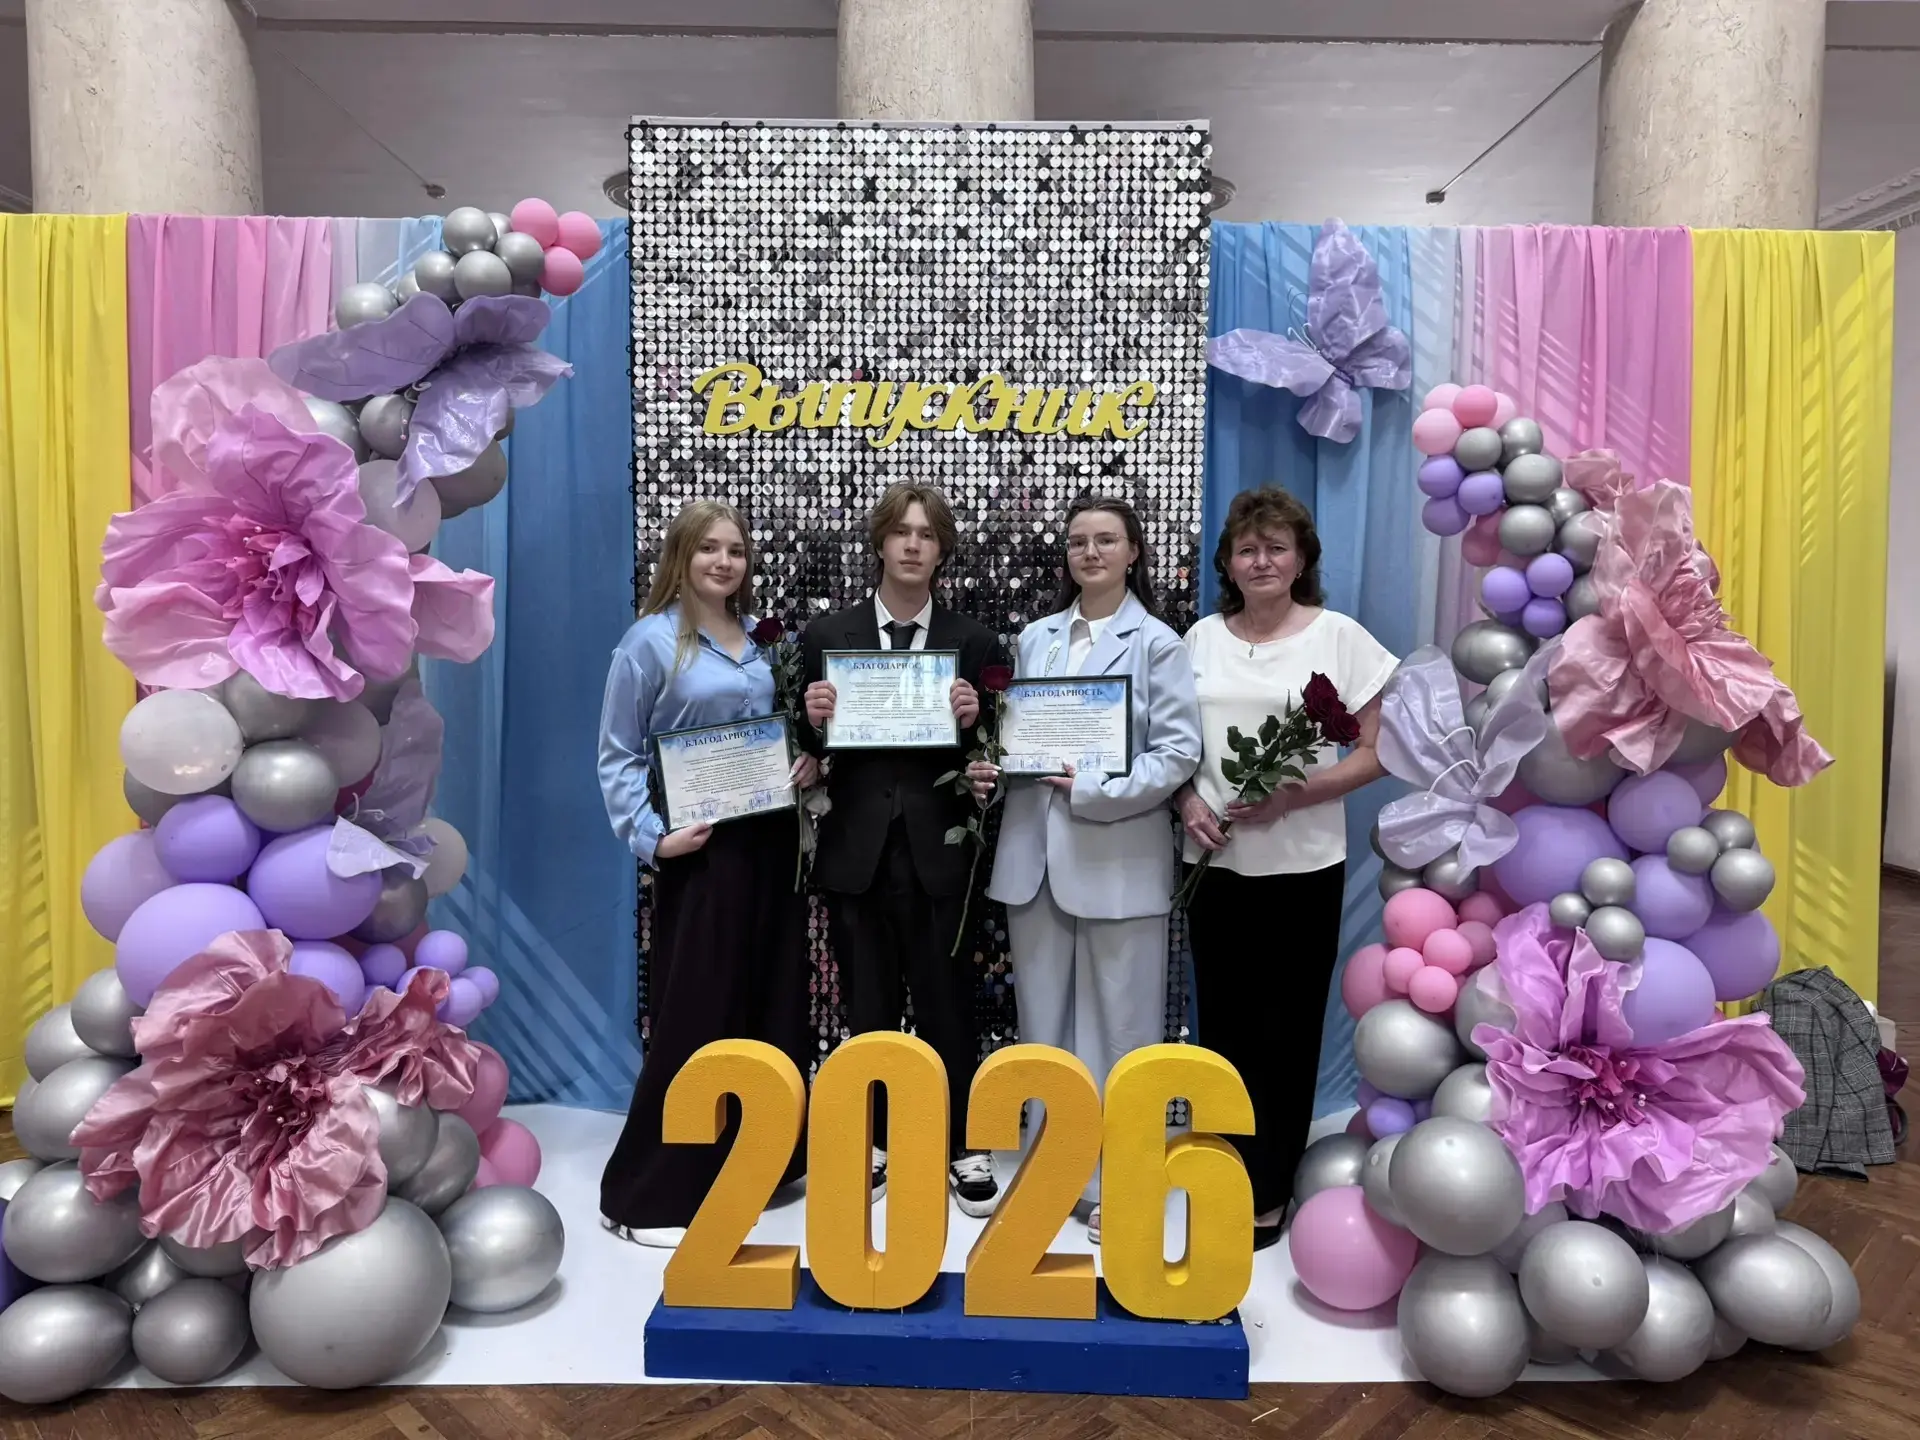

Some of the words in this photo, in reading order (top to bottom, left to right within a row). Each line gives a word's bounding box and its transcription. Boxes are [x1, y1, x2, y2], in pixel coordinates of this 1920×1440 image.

[693, 362, 1155, 448] Выпускник
[853, 661, 930, 671] БЛАГОДАРНОС
[1024, 688, 1103, 698] БЛАГОДАРНОСТЬ
[685, 727, 764, 748] БЛАГОДАРНОСТЬ
[662, 1030, 1256, 1321] 2026
